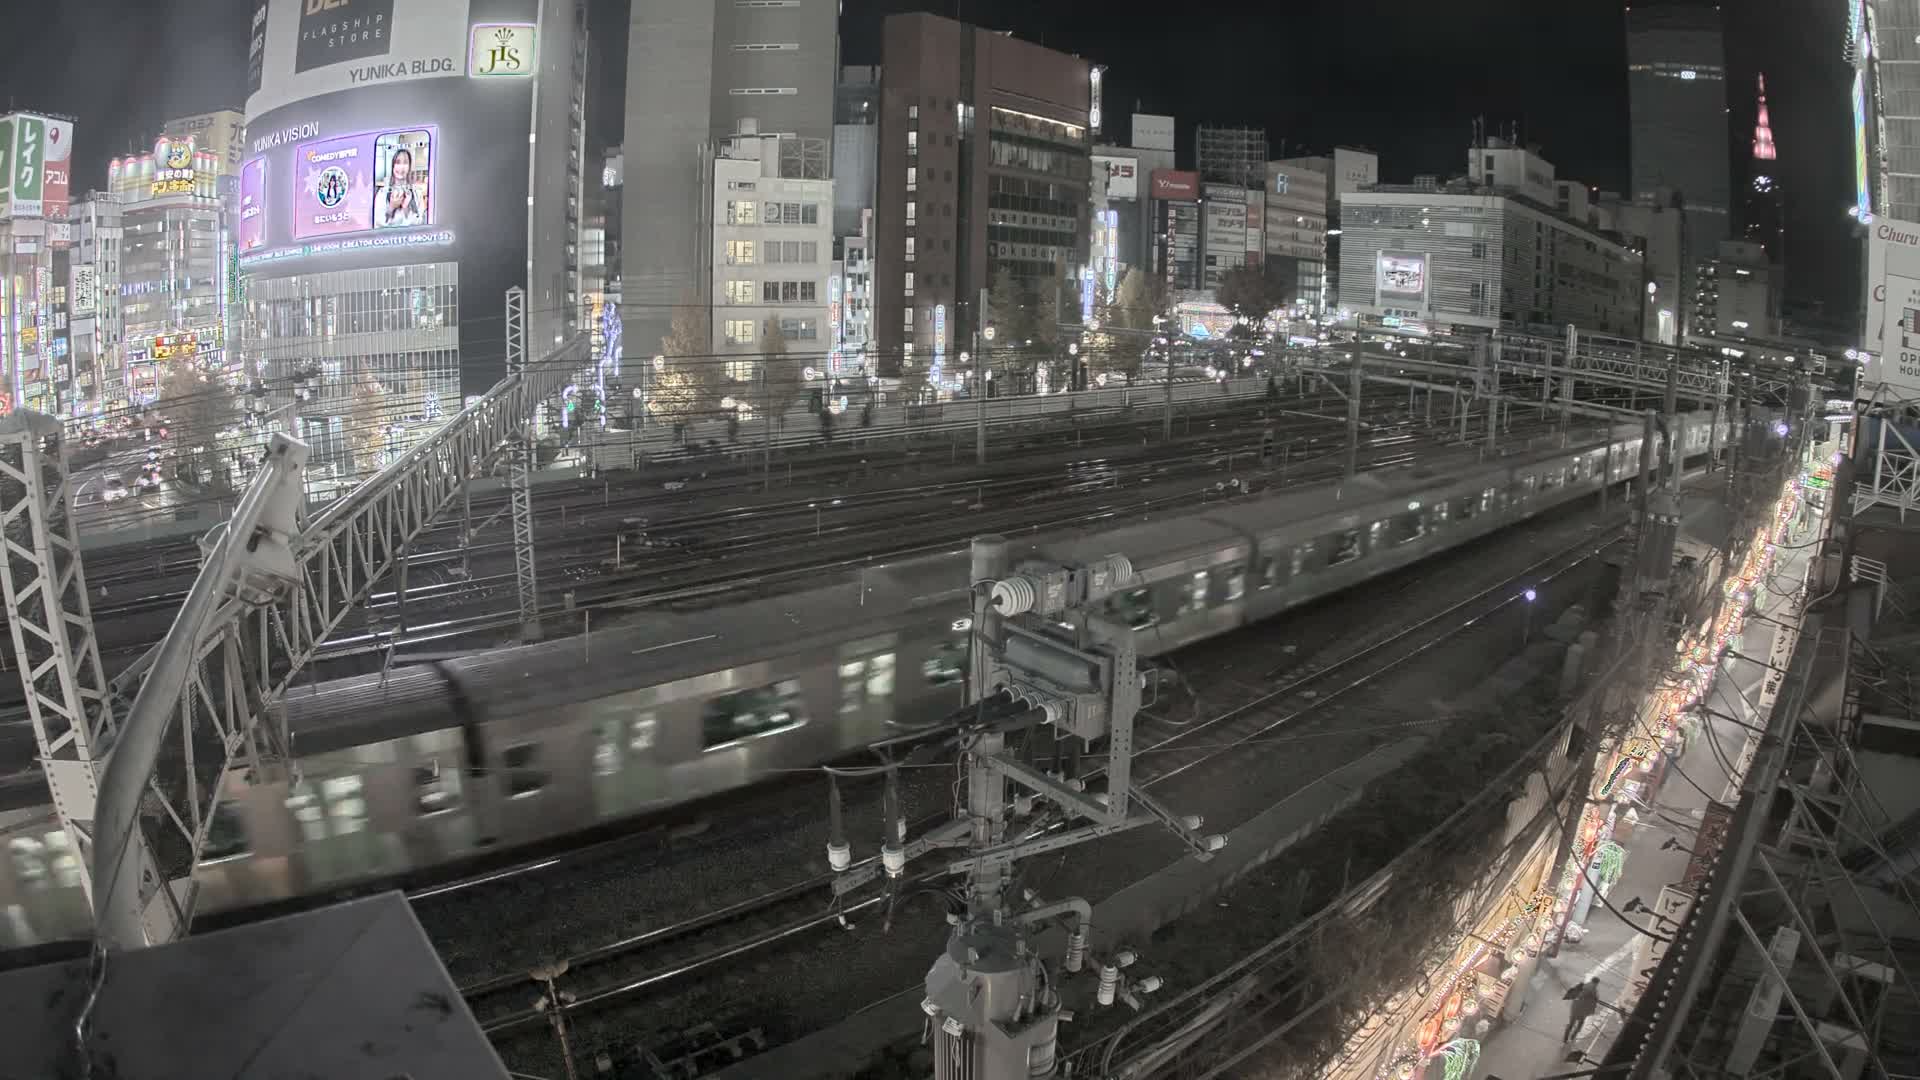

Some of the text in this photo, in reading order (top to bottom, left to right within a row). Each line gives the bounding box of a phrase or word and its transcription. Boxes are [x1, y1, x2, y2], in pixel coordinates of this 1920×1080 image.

[303, 14, 384, 42] FLAGSHIP
[329, 28, 383, 47] STORE
[350, 57, 457, 83] YUNIKA BLDG.
[254, 121, 319, 153] YUNIKA VISION
[20, 120, 37, 188] レイク
[45, 170, 68, 185] アコム
[1877, 224, 1919, 245] Churu
